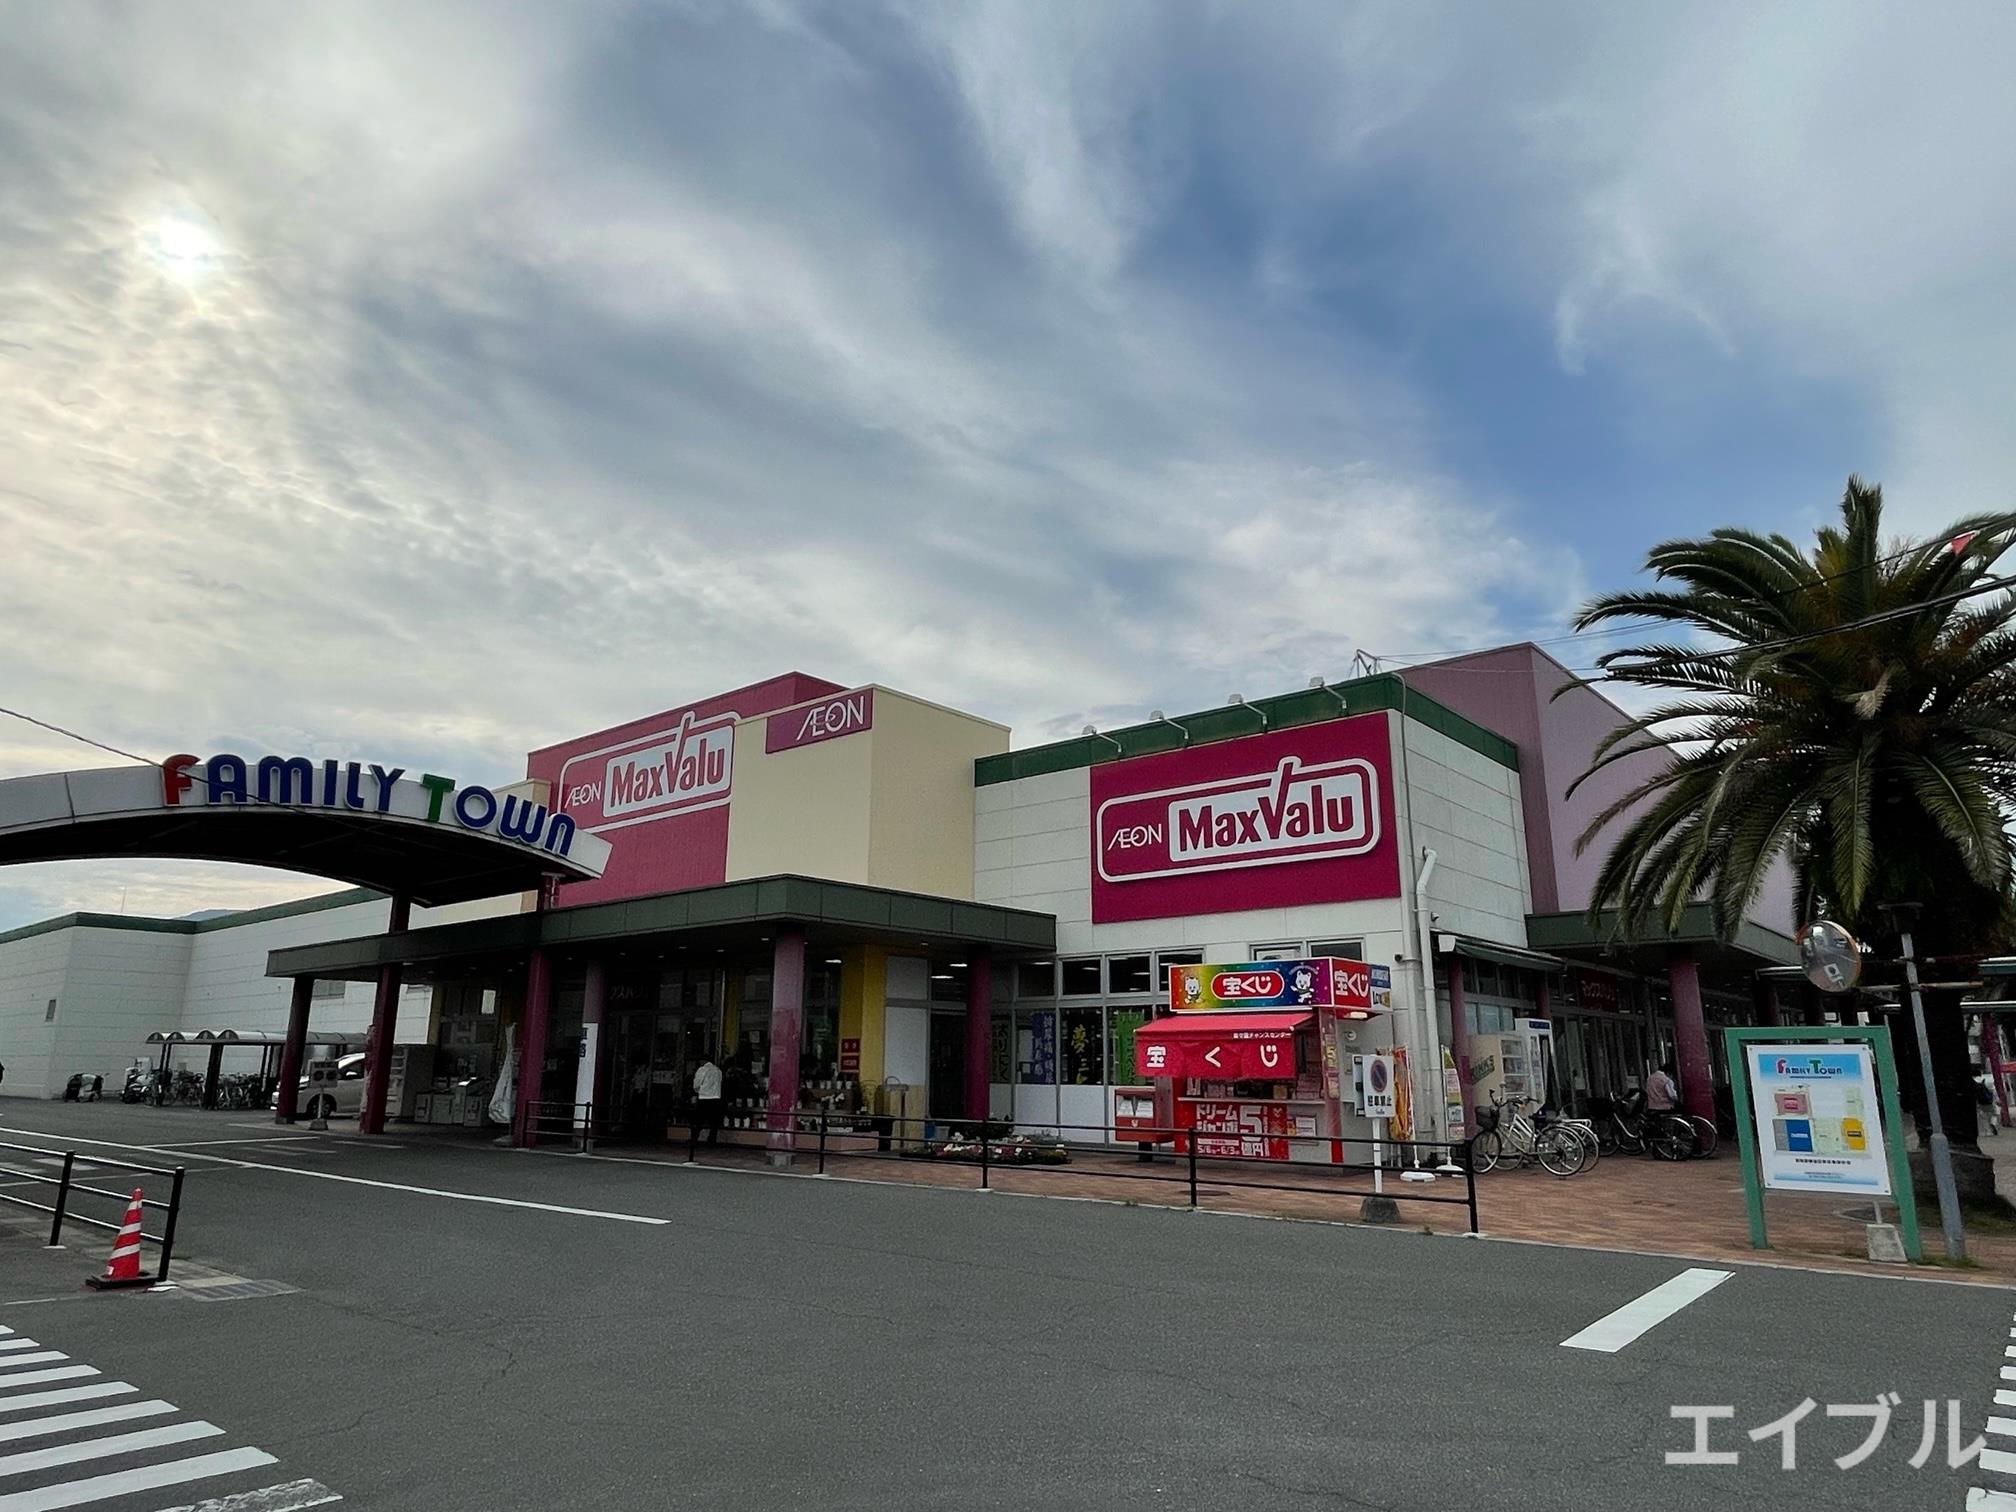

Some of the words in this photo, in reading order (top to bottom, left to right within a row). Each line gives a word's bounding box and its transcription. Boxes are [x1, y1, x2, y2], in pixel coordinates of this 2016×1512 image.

[610, 717, 725, 808] MaxValu
[162, 753, 406, 813] FAMILY
[420, 773, 578, 857] TOWN
[1178, 762, 1354, 853] MaxValu
[1222, 976, 1272, 996] 宝くじ
[1334, 969, 1369, 999] 宝くじ
[1776, 1058, 1811, 1075] FAMILY
[1809, 1059, 1843, 1075] TOWN
[1196, 1103, 1239, 1121] ドリーム
